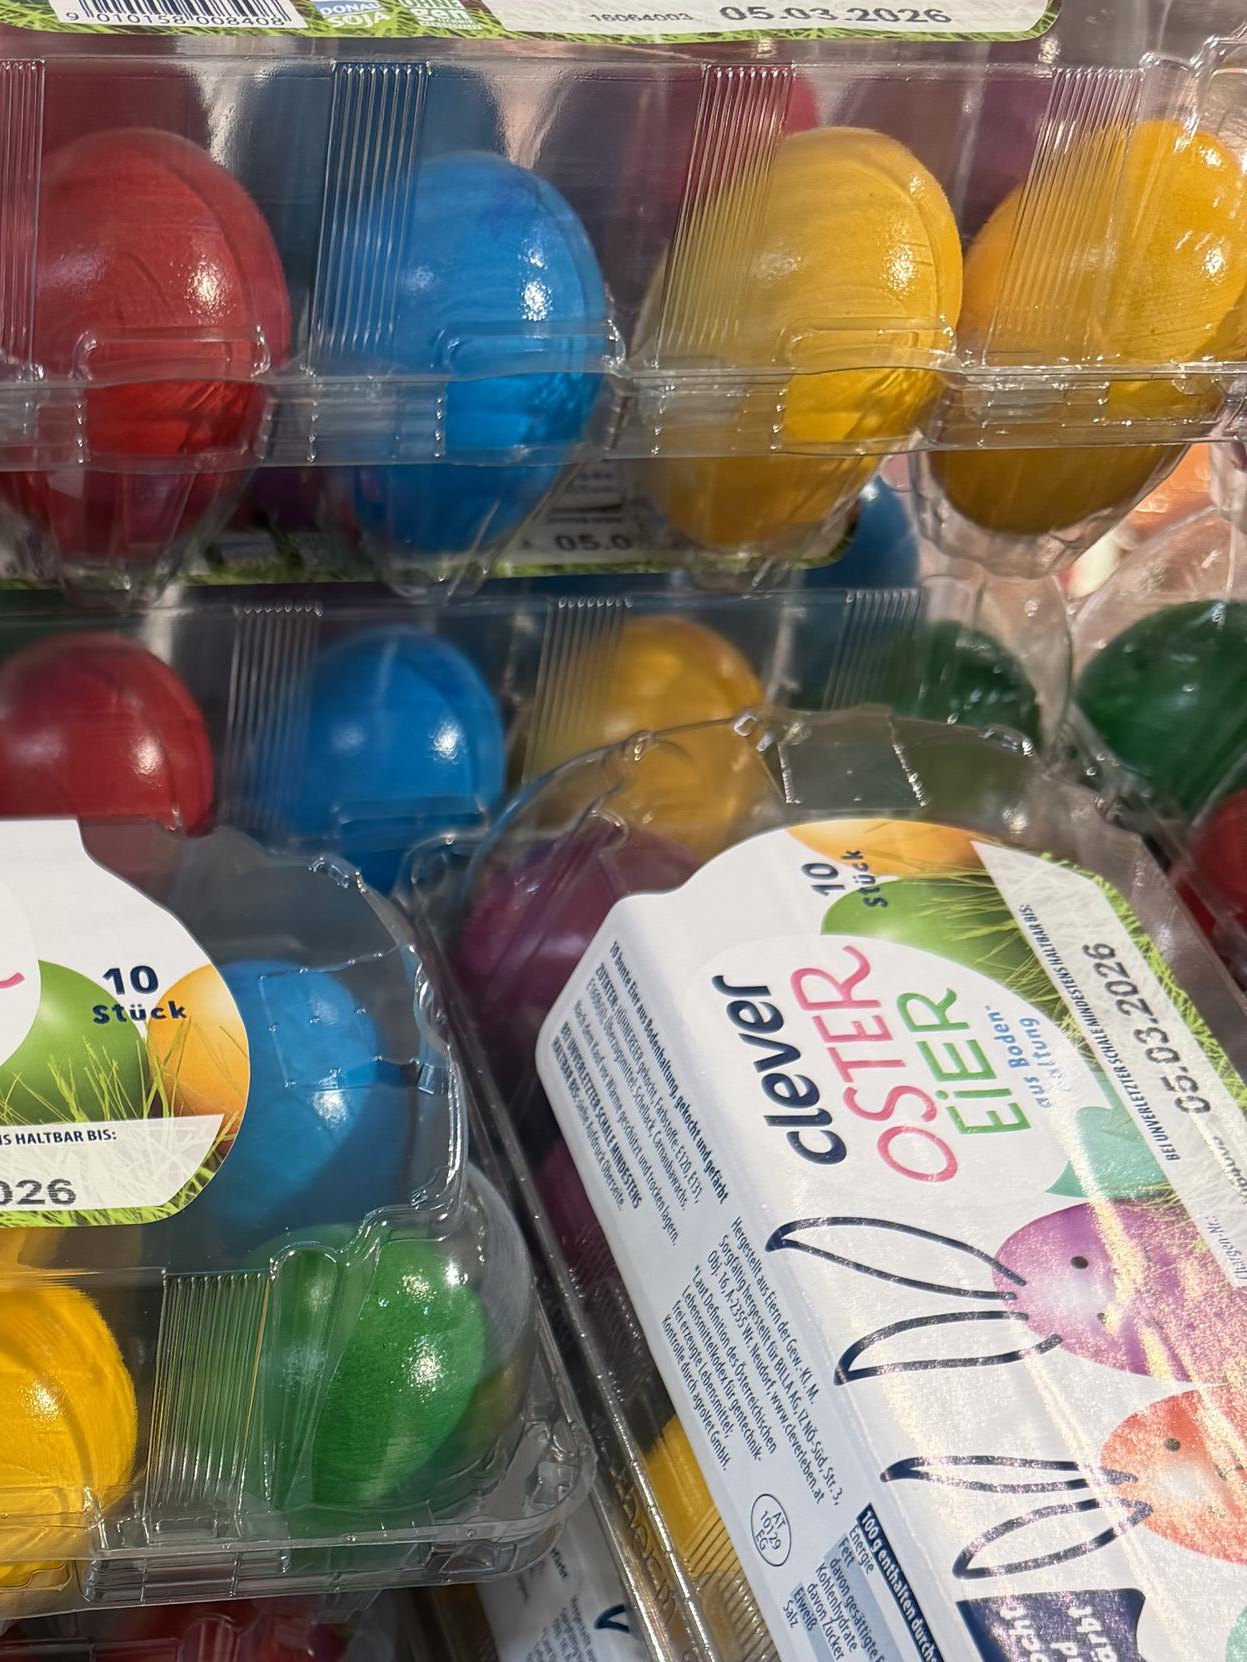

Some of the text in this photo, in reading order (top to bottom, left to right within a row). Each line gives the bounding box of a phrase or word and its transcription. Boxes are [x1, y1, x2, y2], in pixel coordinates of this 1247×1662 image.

[66, 12, 283, 27] 9 010158 008408
[332, 10, 390, 28] SOJA
[591, 6, 952, 25] 16064003 05.03.2026
[801, 862, 846, 897] 10
[841, 850, 889, 908] Stück
[91, 1000, 187, 1024] Stück
[101, 965, 160, 997] 10
[985, 1005, 1030, 1068] Boden-
[1016, 902, 1181, 1163] BEI UNVERLETZTER SCHALE MINDESTENS HALTBAR BIS:
[1083, 943, 1210, 1114] 05.03.2026
[711, 975, 847, 1166] clever
[790, 945, 959, 1183] OSTER
[15, 1131, 83, 1145] HALTBAR
[86, 1129, 117, 1143] BIS:
[593, 1103, 643, 1212] SCHALE MINDESTENS
[673, 1089, 729, 1207] gekocht und gefärbt
[728, 1214, 792, 1345] Hergestellt aus Eiern der
[670, 1296, 704, 1373] frei erzeugte
[716, 1230, 839, 1496] Sorgfältig hergestellt für BILLA AG, Str.
[660, 1311, 732, 1474] Kontrolle durch agroVet GmbH.
[681, 1281, 765, 1470] Lebensmittelkodex für gentechnik-
[702, 1290, 780, 1457] Definition des Österreichischen
[705, 1246, 826, 1507] Obj. 16, A-2355 Wr. Neudorf, www.cleverleben.at
[758, 1507, 782, 1555] 10129
[837, 1534, 856, 1569] Fett
[845, 1521, 876, 1580] Energie
[805, 1576, 829, 1624] davon
[813, 1558, 860, 1656] Kohlenhydrate
[828, 1552, 852, 1599] davon
[876, 1540, 919, 1628] enthalten
[782, 1596, 800, 1631] Salz
[792, 1584, 818, 1634] Eiweiß
